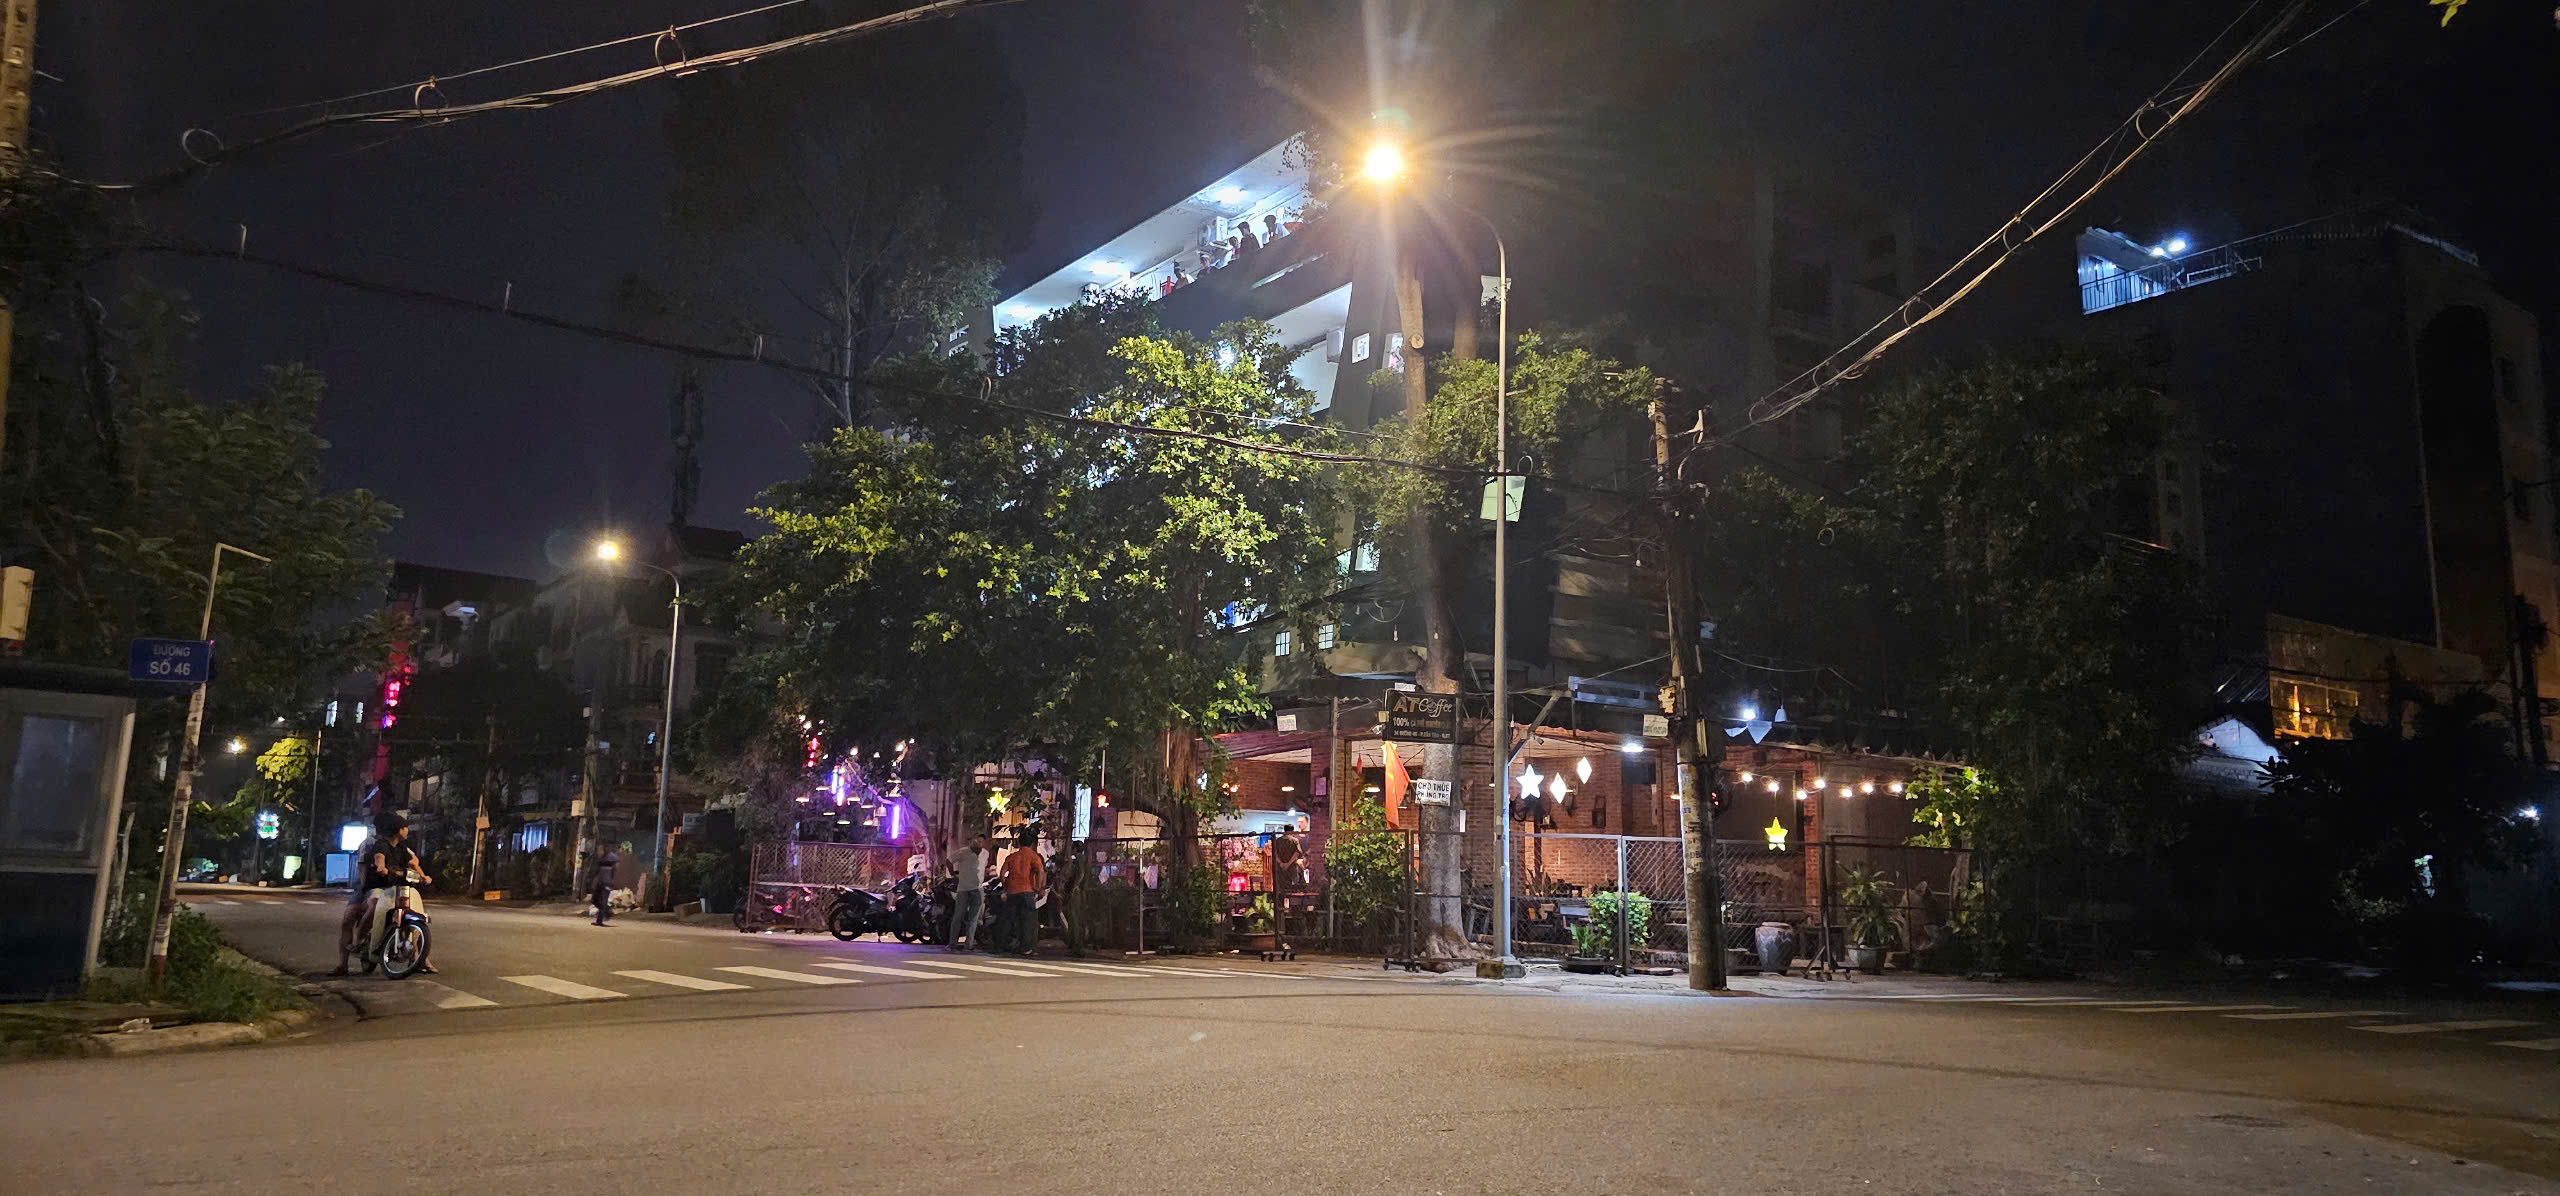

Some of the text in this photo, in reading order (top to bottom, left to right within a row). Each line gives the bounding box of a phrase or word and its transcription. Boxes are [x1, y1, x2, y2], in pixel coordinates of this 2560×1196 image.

[149, 657, 191, 676] SỐ 46
[1392, 697, 1452, 717] AT Coffee
[1393, 717, 1409, 726] 100%
[1418, 782, 1431, 790] CHO
